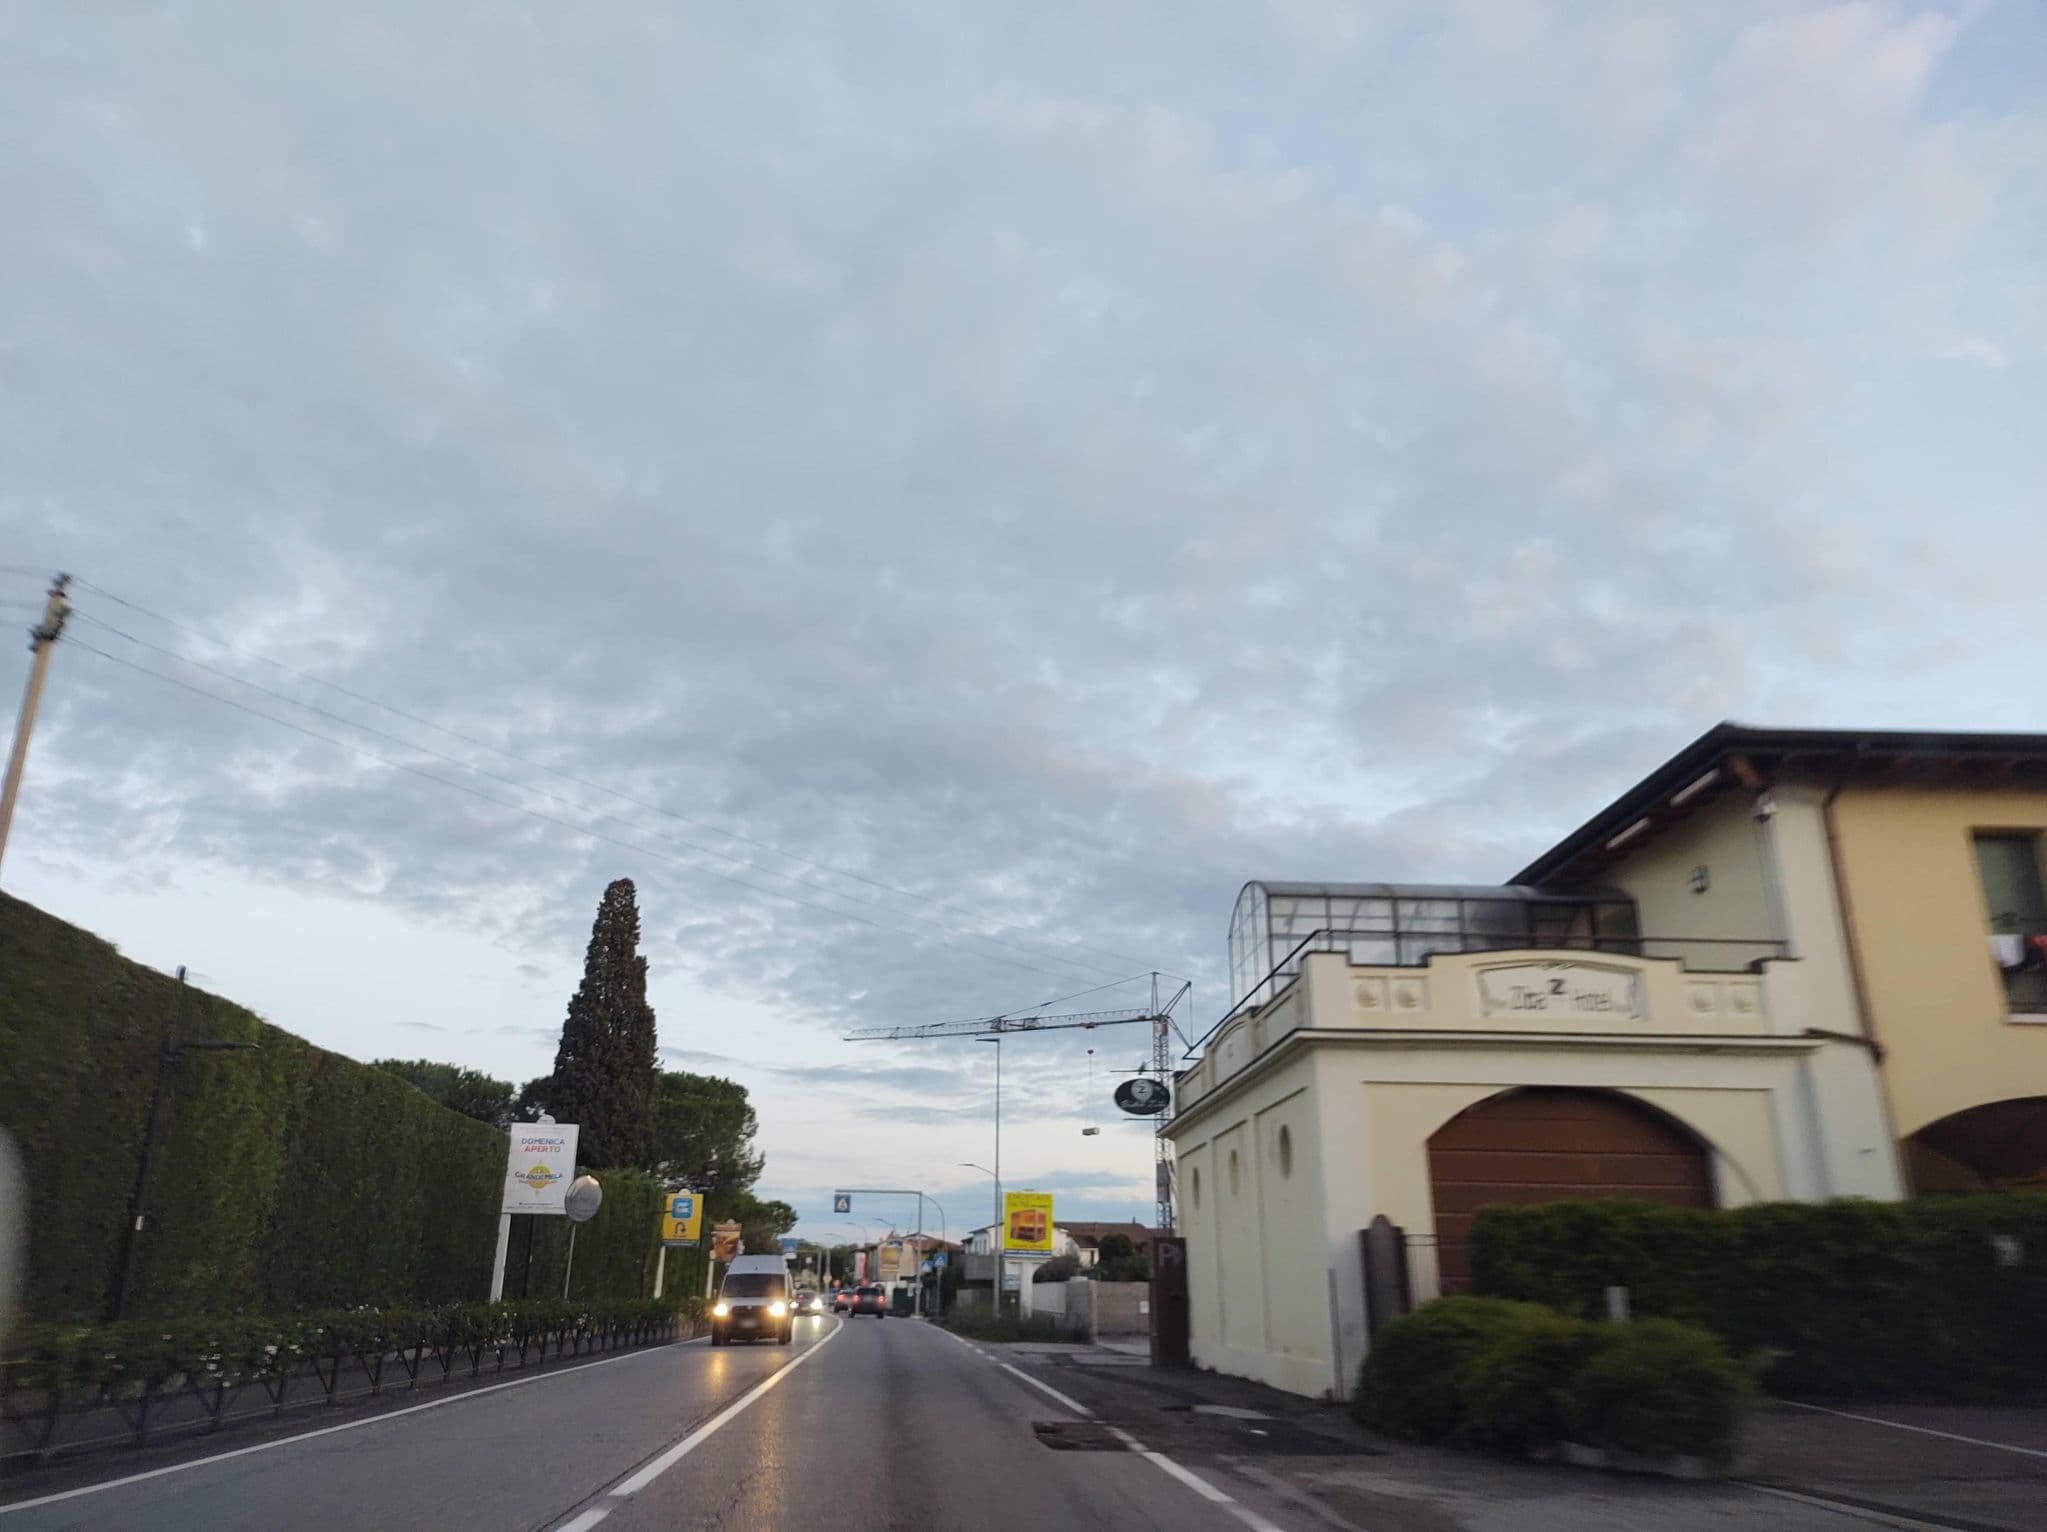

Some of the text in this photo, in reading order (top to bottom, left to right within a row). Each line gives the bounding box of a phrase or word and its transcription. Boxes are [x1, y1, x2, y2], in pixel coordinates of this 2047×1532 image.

[1548, 978, 1567, 995] Z
[521, 1137, 566, 1145] DOMENICA
[524, 1145, 561, 1153] APERTO
